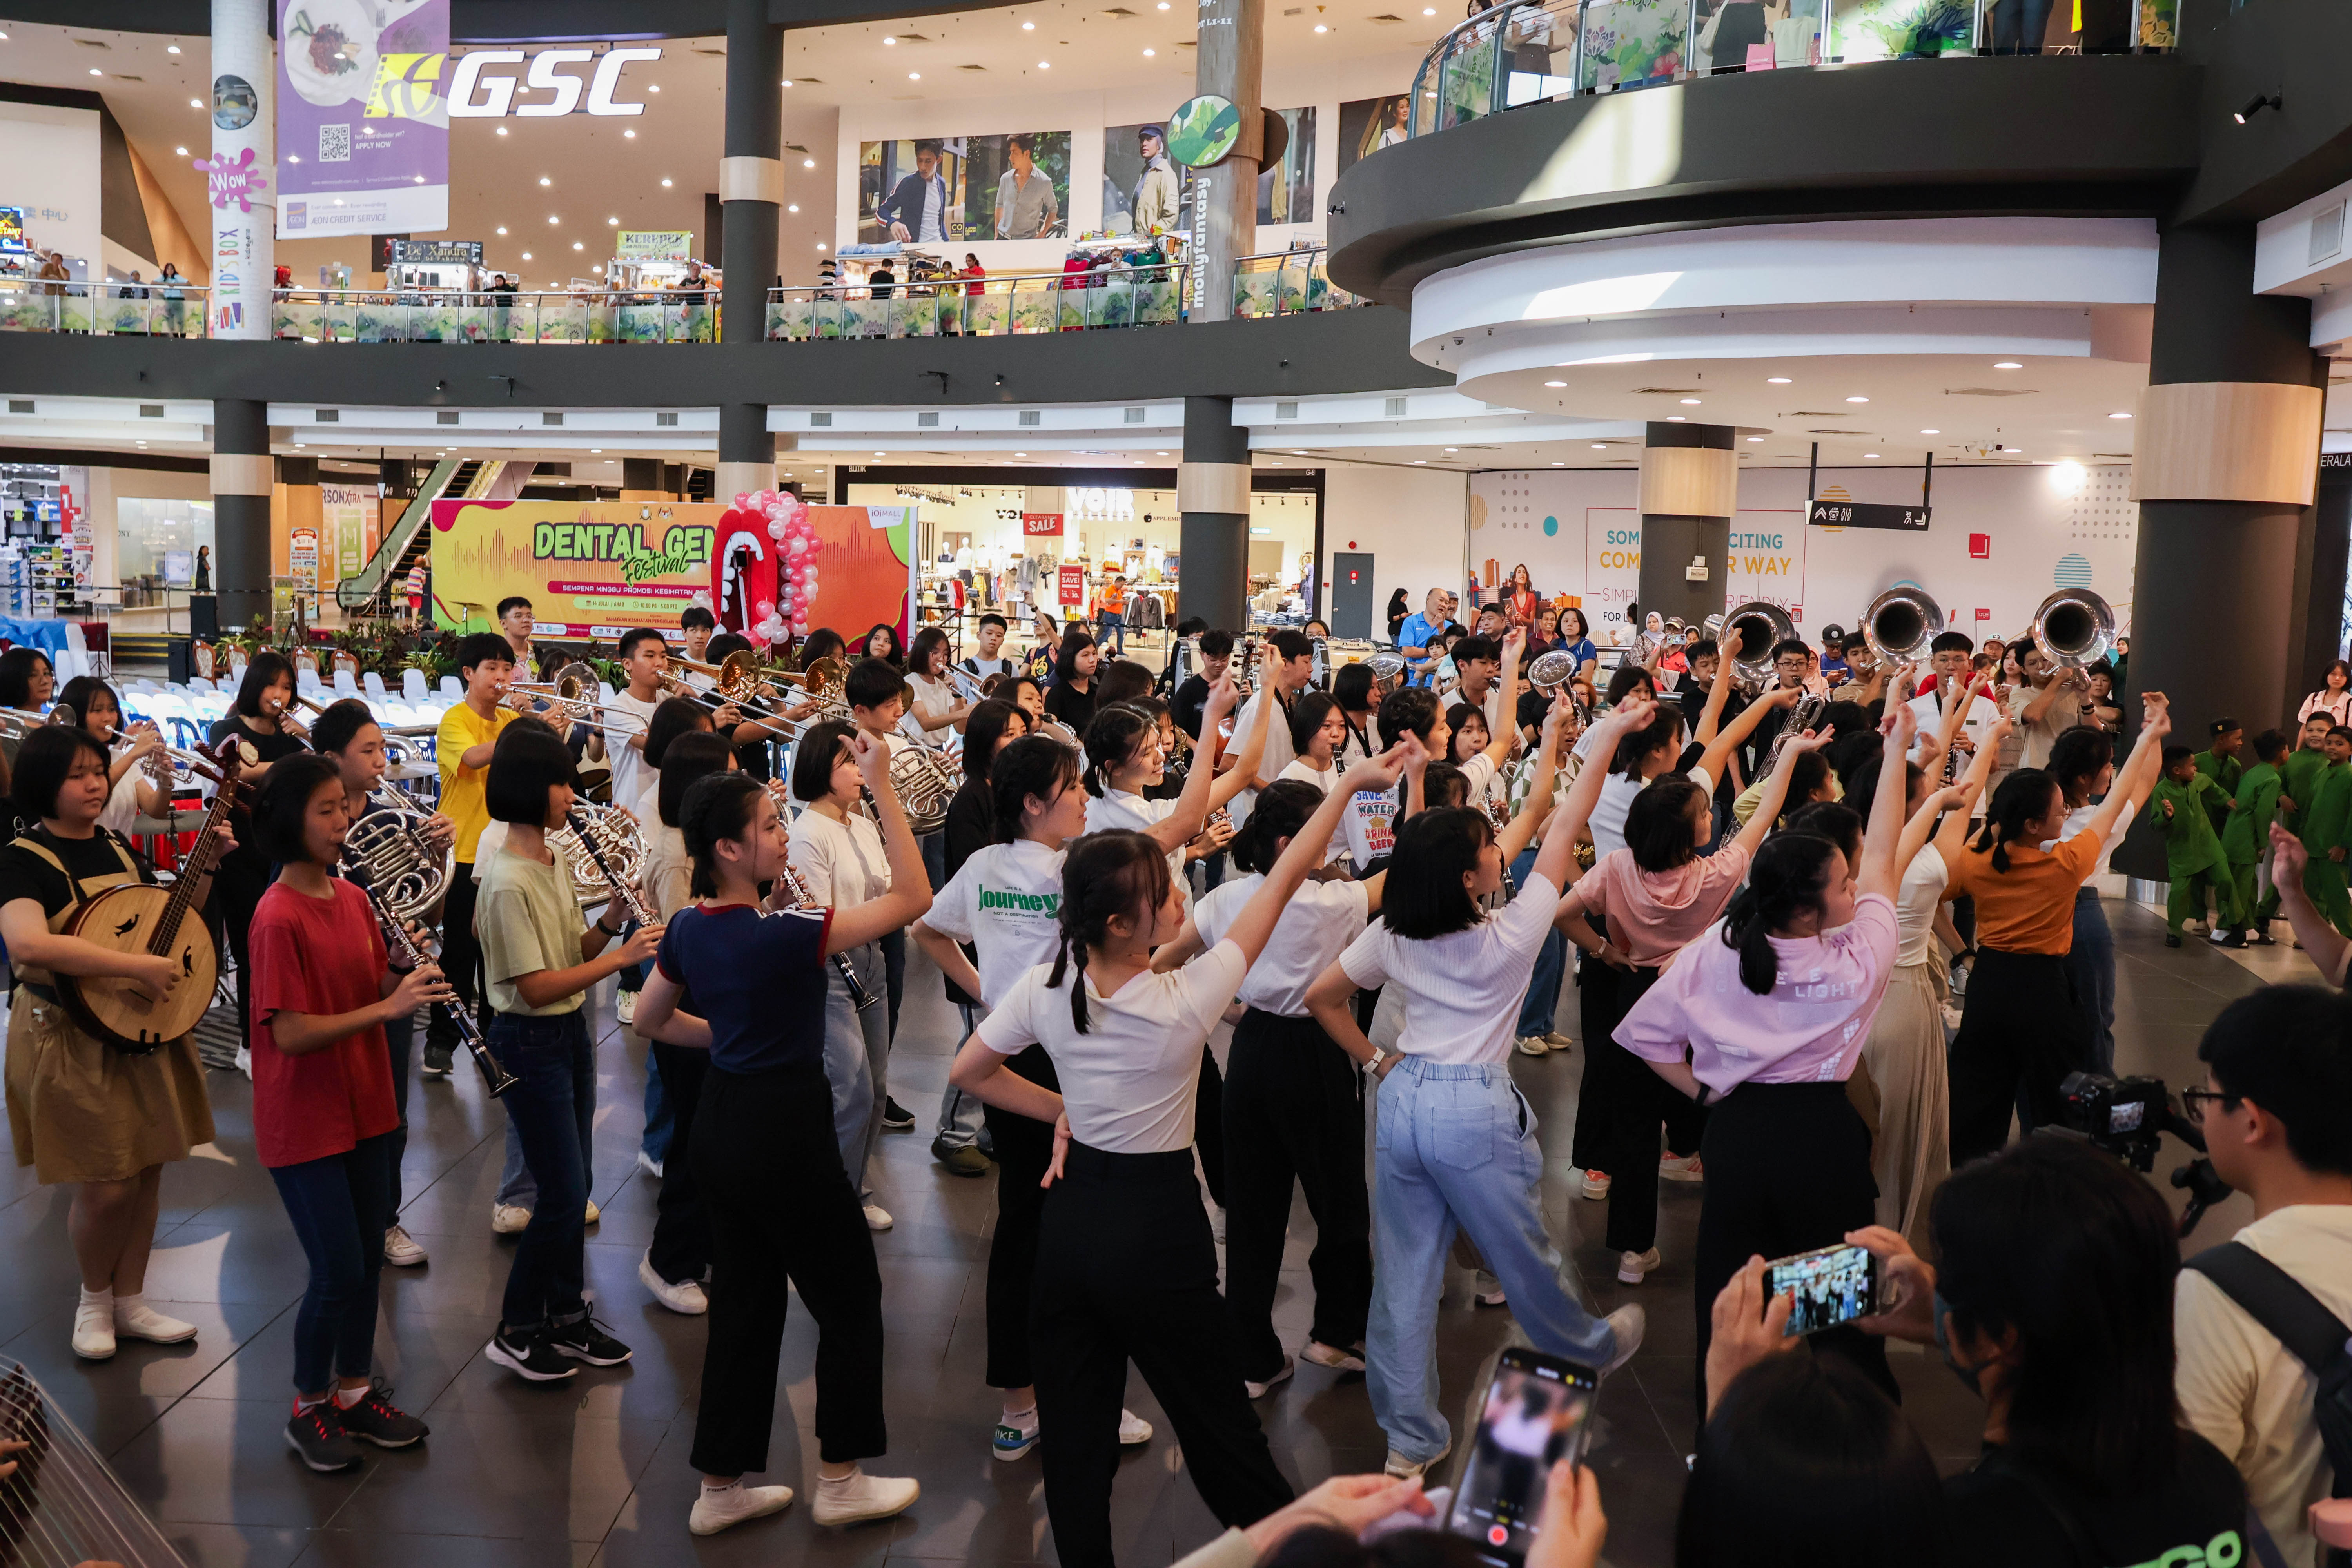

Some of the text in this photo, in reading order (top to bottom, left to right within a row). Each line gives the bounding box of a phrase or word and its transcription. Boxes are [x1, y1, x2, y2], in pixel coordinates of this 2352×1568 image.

[447, 48, 662, 117] GSC
[355, 141, 374, 150] APPLY
[213, 172, 247, 192] Wow
[330, 215, 355, 223] CREDIT
[357, 213, 387, 222] SERVICE
[428, 244, 467, 256] Xandra
[1193, 178, 1211, 308] mollyfantasy
[218, 229, 240, 295] KID'S BOX
[2321, 454, 2352, 467] ERALA
[1067, 488, 1135, 512] VOIR
[1029, 517, 1056, 532] SALE
[535, 523, 652, 561] DENTAL
[1607, 530, 1783, 549] SOM CITING
[620, 550, 691, 587] Festival
[1600, 551, 1640, 569] COM
[1744, 556, 1792, 576] WAY
[1603, 612, 1621, 622] FOR
[1356, 790, 1382, 801] SAVE
[1357, 803, 1396, 816] WATER
[1369, 838, 1394, 851] BEER
[1795, 980, 1858, 998] LIGHT
